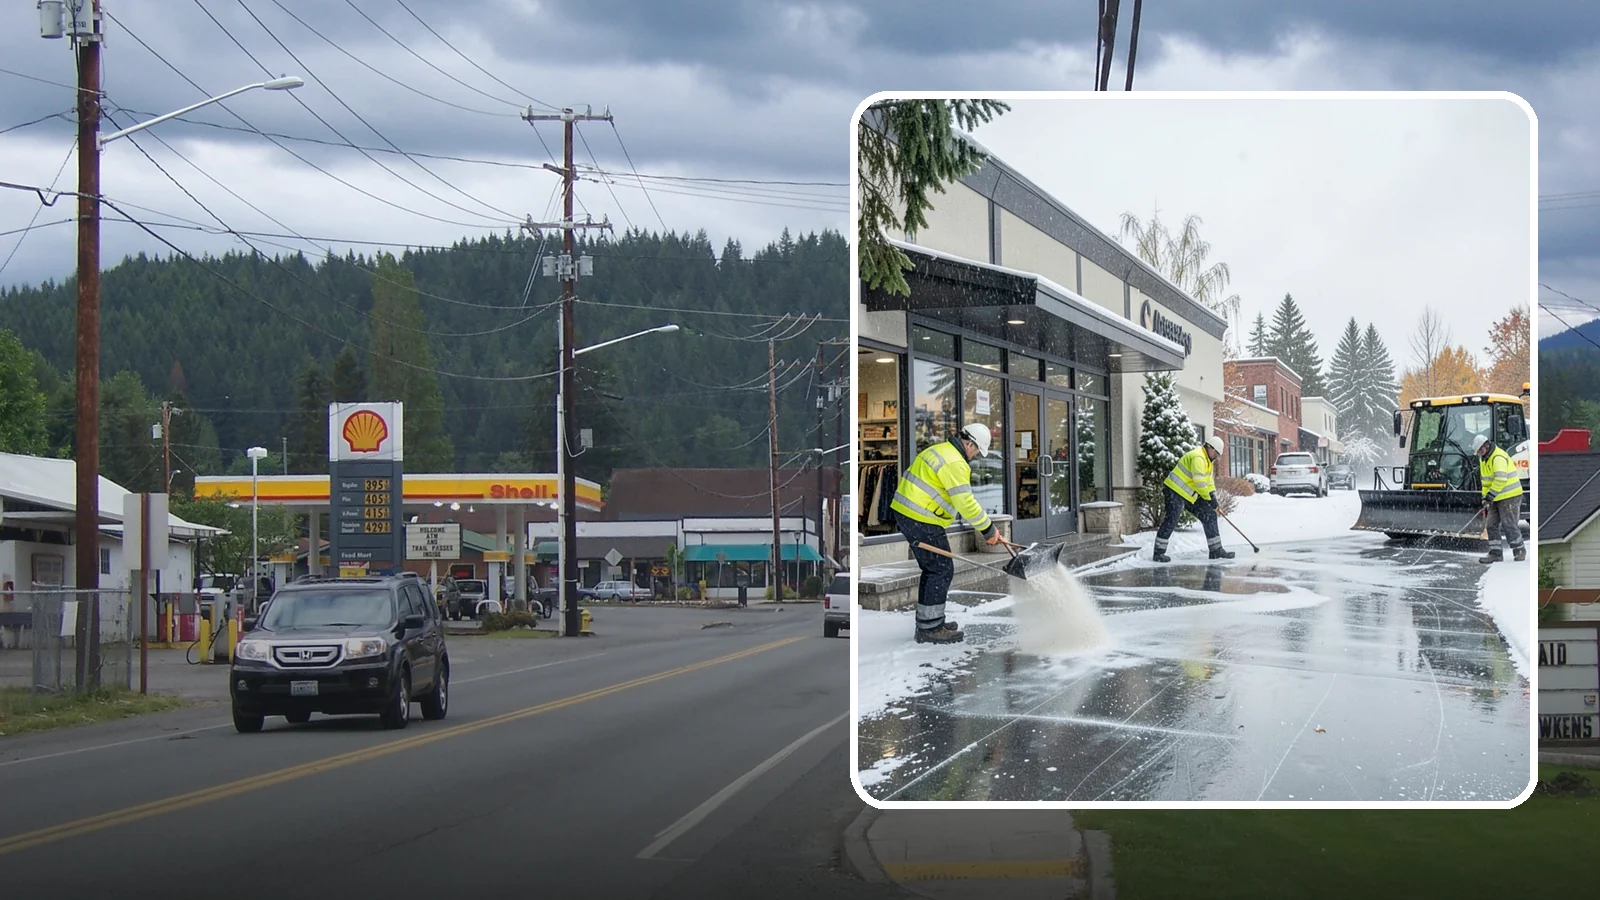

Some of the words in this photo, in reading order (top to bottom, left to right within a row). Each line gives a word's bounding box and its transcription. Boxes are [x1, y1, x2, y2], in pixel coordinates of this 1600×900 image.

[366, 480, 383, 490] 395
[490, 484, 547, 499] Shell
[366, 494, 383, 504] 405
[366, 508, 383, 518] 415
[366, 522, 383, 532] 429
